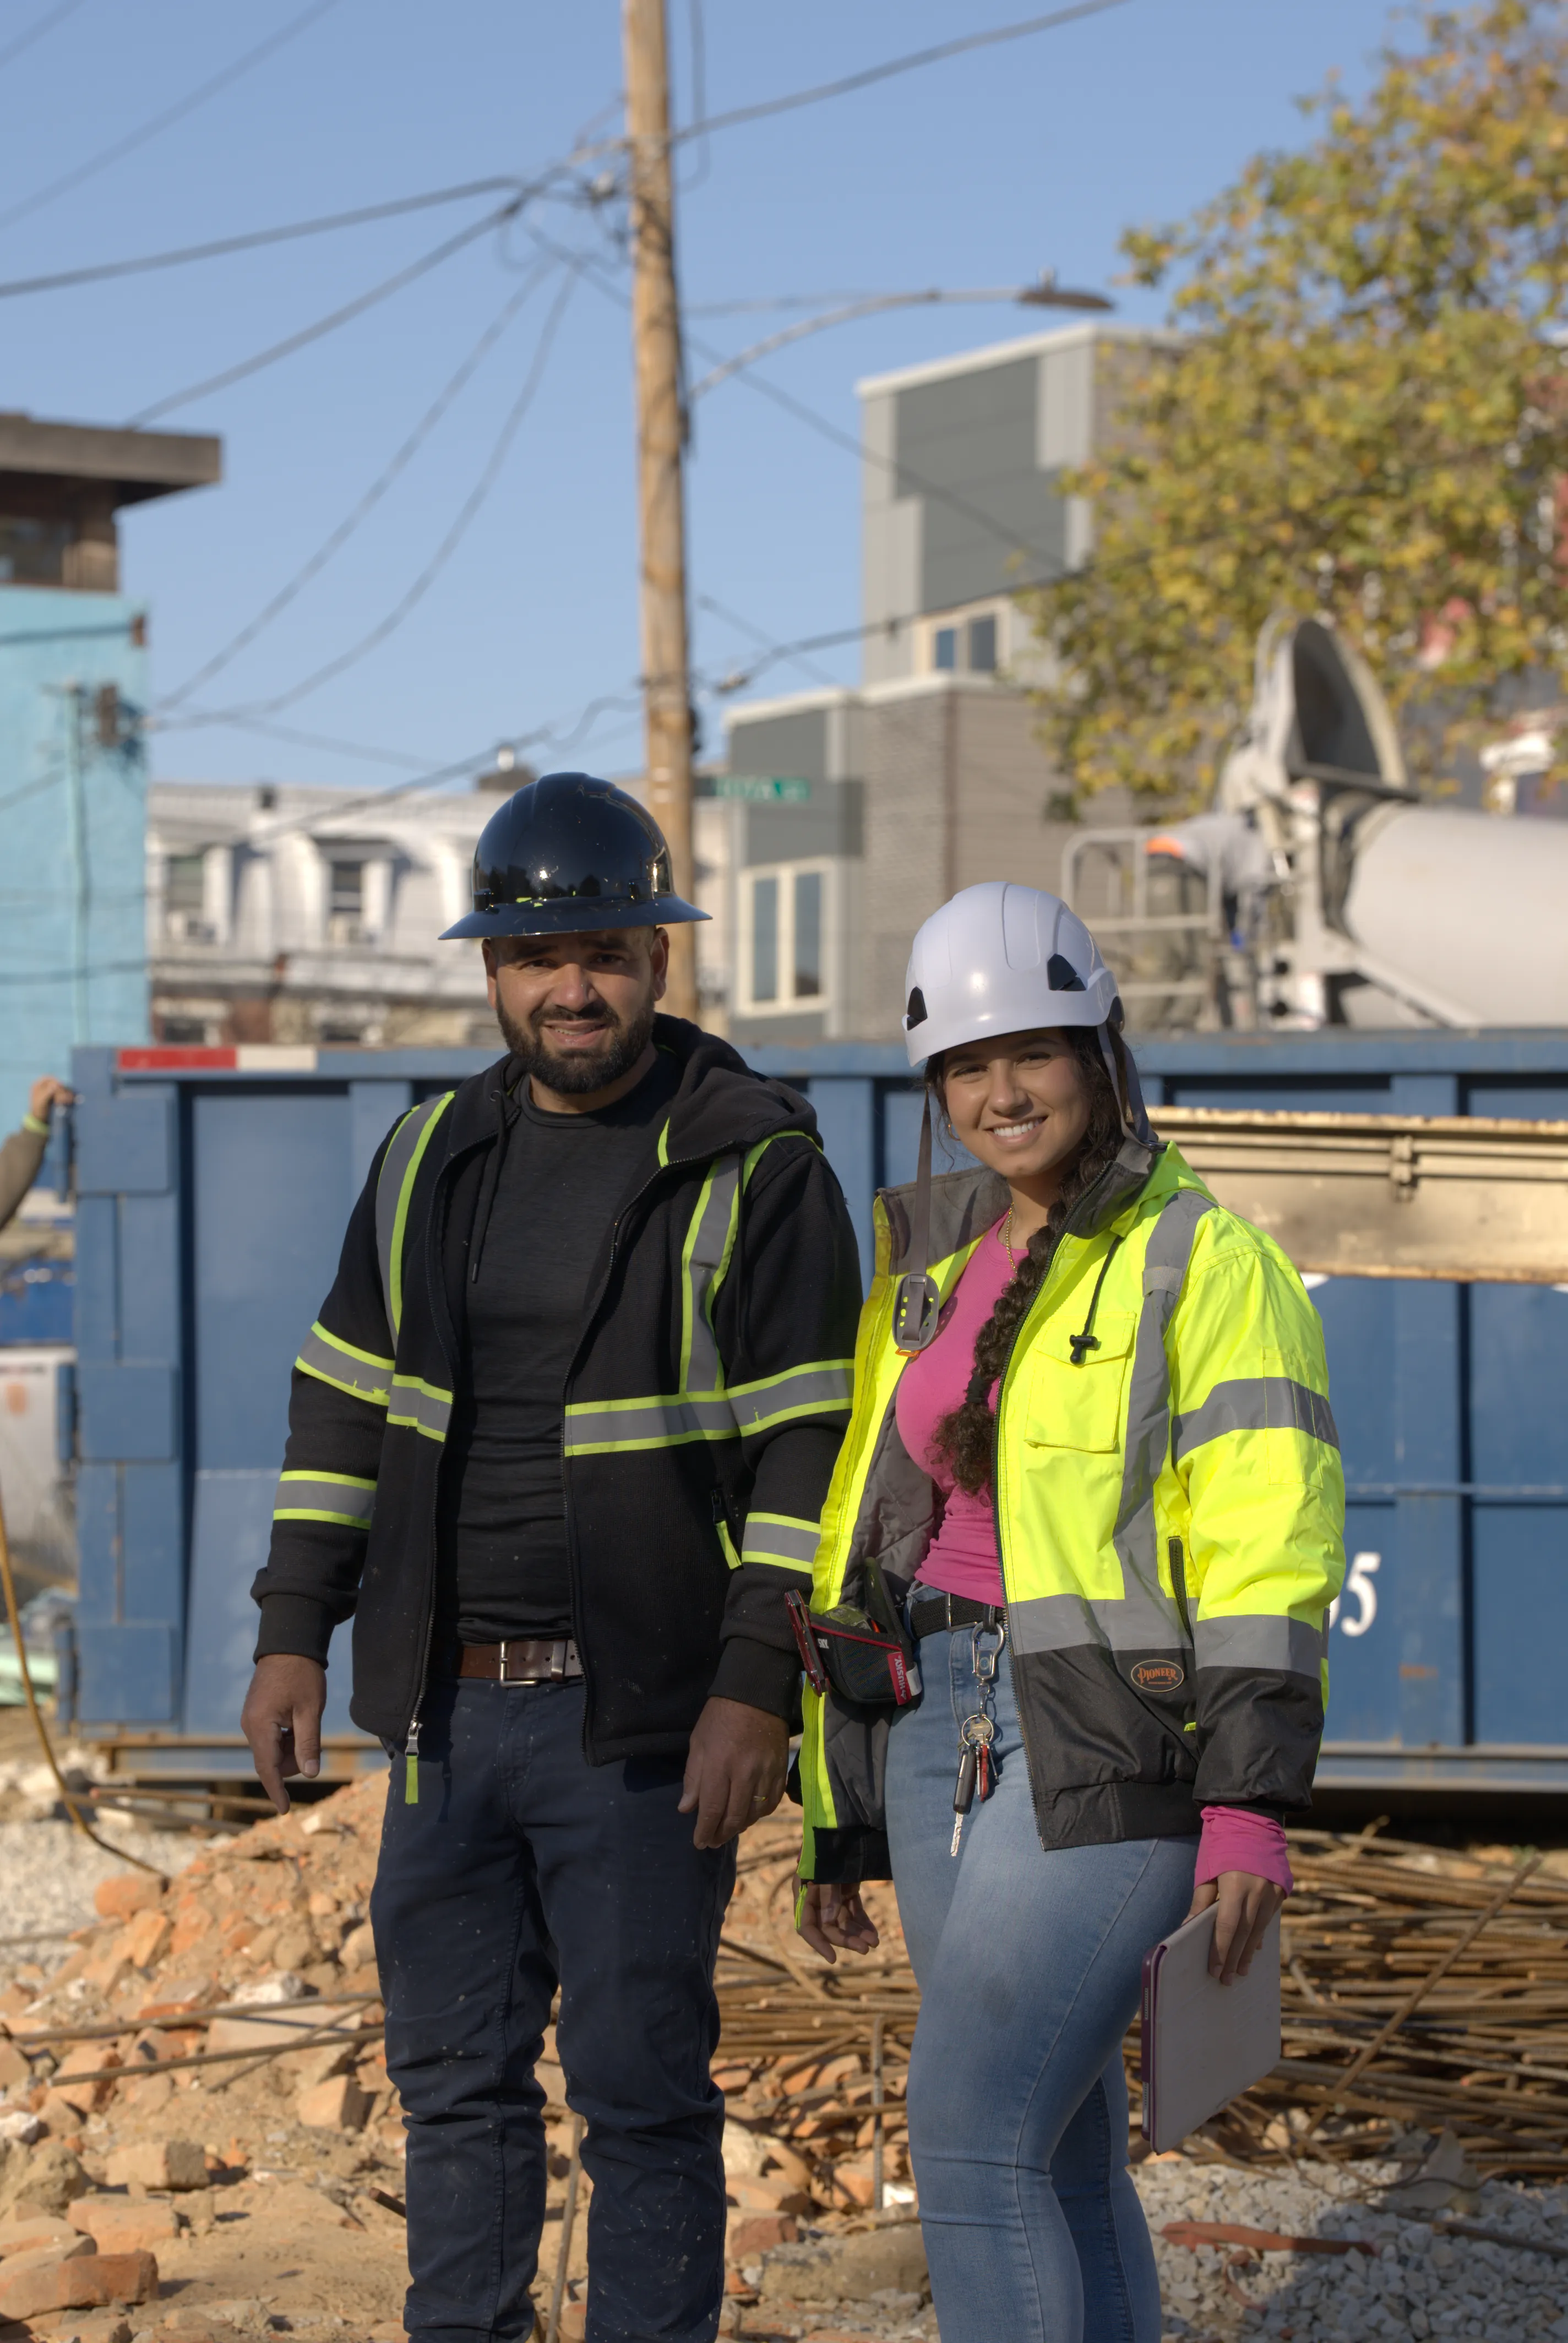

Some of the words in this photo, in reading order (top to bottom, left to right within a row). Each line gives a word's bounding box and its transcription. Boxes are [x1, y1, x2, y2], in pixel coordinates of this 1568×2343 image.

[1330, 1551, 1381, 1637] 5
[894, 1658, 906, 1690] HUSKY
[1137, 1667, 1178, 1685] PIONEER
